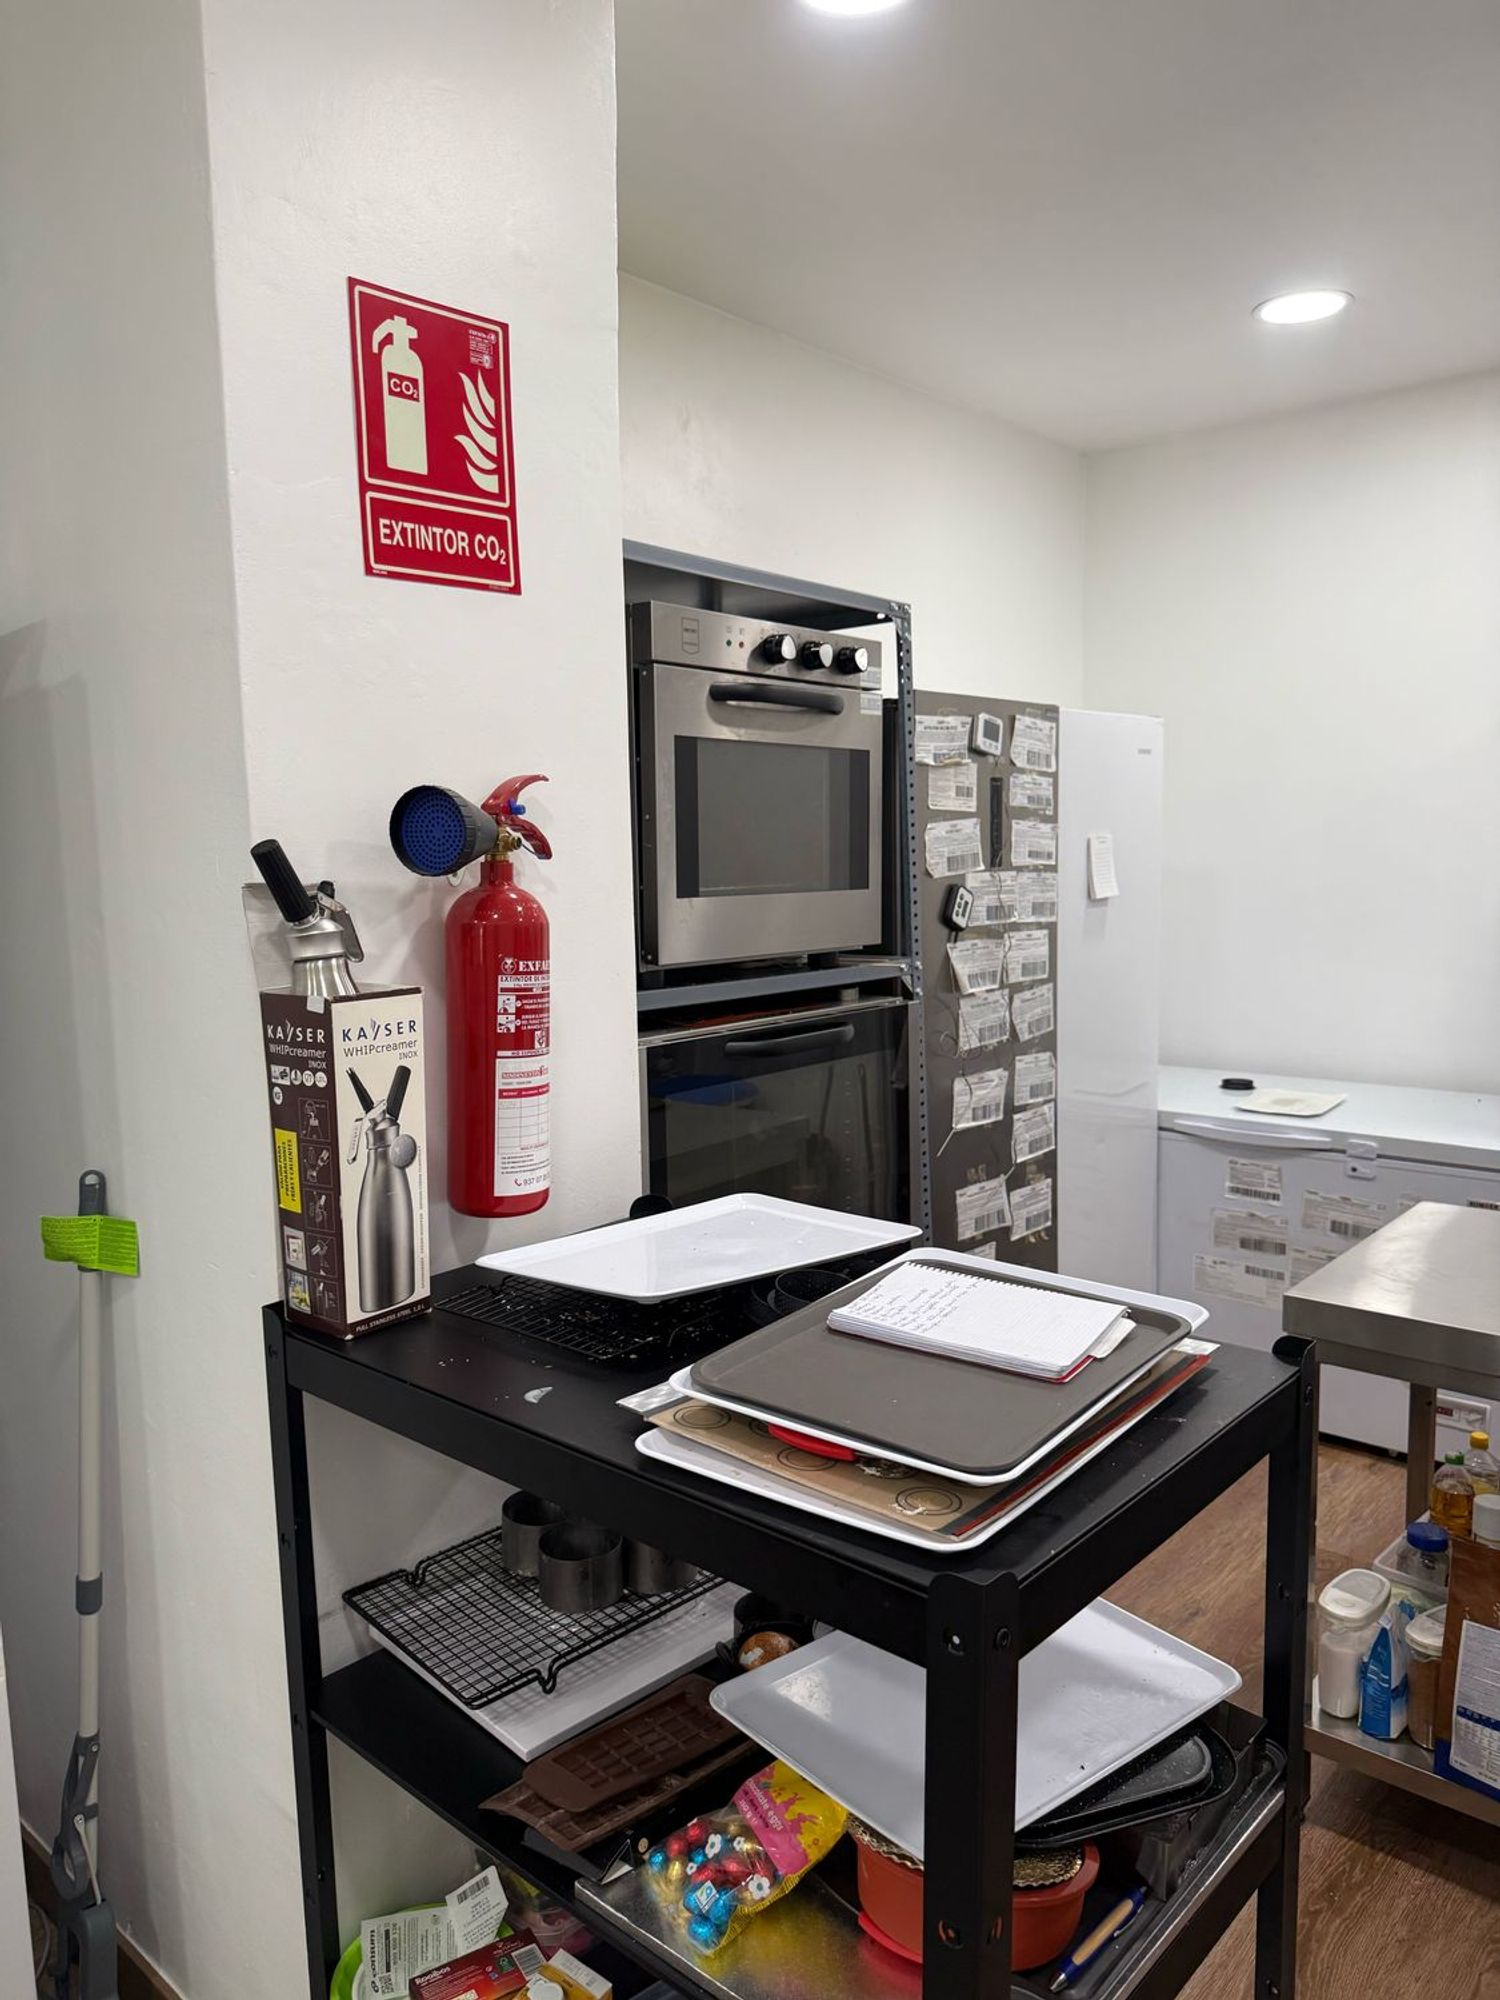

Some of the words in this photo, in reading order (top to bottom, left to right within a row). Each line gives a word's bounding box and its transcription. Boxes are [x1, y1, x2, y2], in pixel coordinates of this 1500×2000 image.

[379, 517, 470, 557] EXTINTOR
[474, 533, 507, 565] CO2
[267, 1019, 326, 1044] KAYSER
[342, 1018, 417, 1042] KAYSER
[269, 1043, 327, 1059] WHIPcreamer
[343, 1040, 418, 1058] WHIPcreamer
[398, 1050, 418, 1060] INOX
[308, 1060, 327, 1069] INOX
